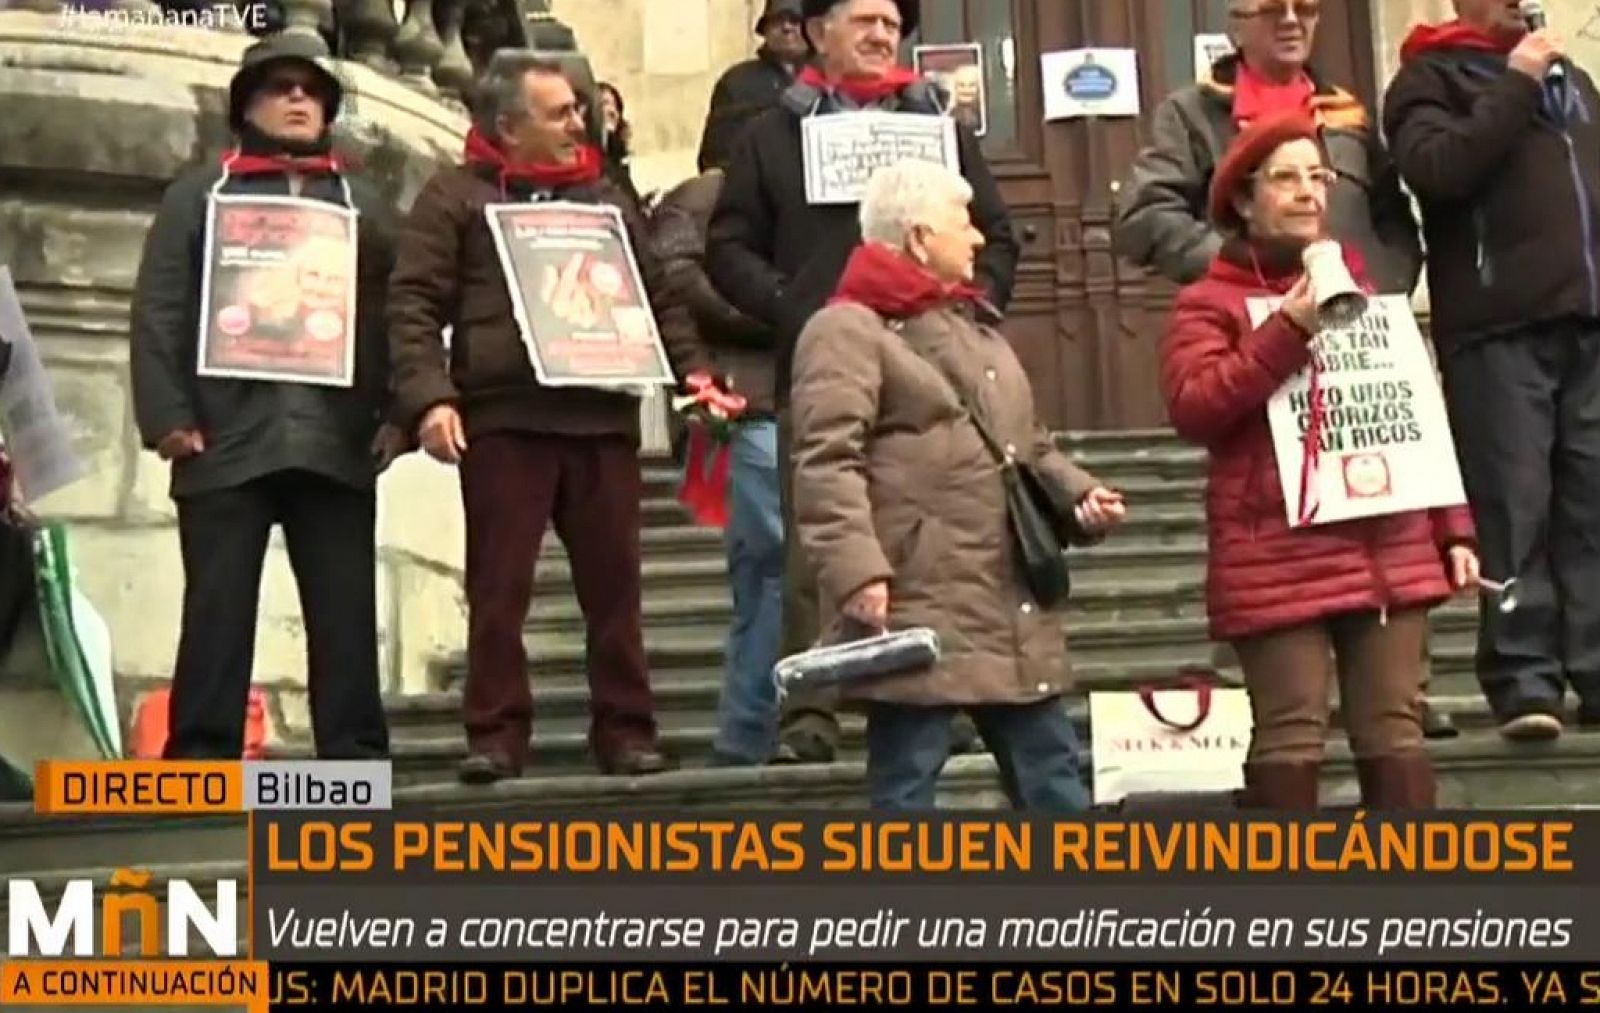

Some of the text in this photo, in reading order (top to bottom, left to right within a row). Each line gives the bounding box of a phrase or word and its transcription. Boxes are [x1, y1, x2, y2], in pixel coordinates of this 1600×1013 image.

[1346, 331, 1390, 350] TAN
[1350, 379, 1413, 404] UNOS
[1352, 421, 1422, 449] RICOS
